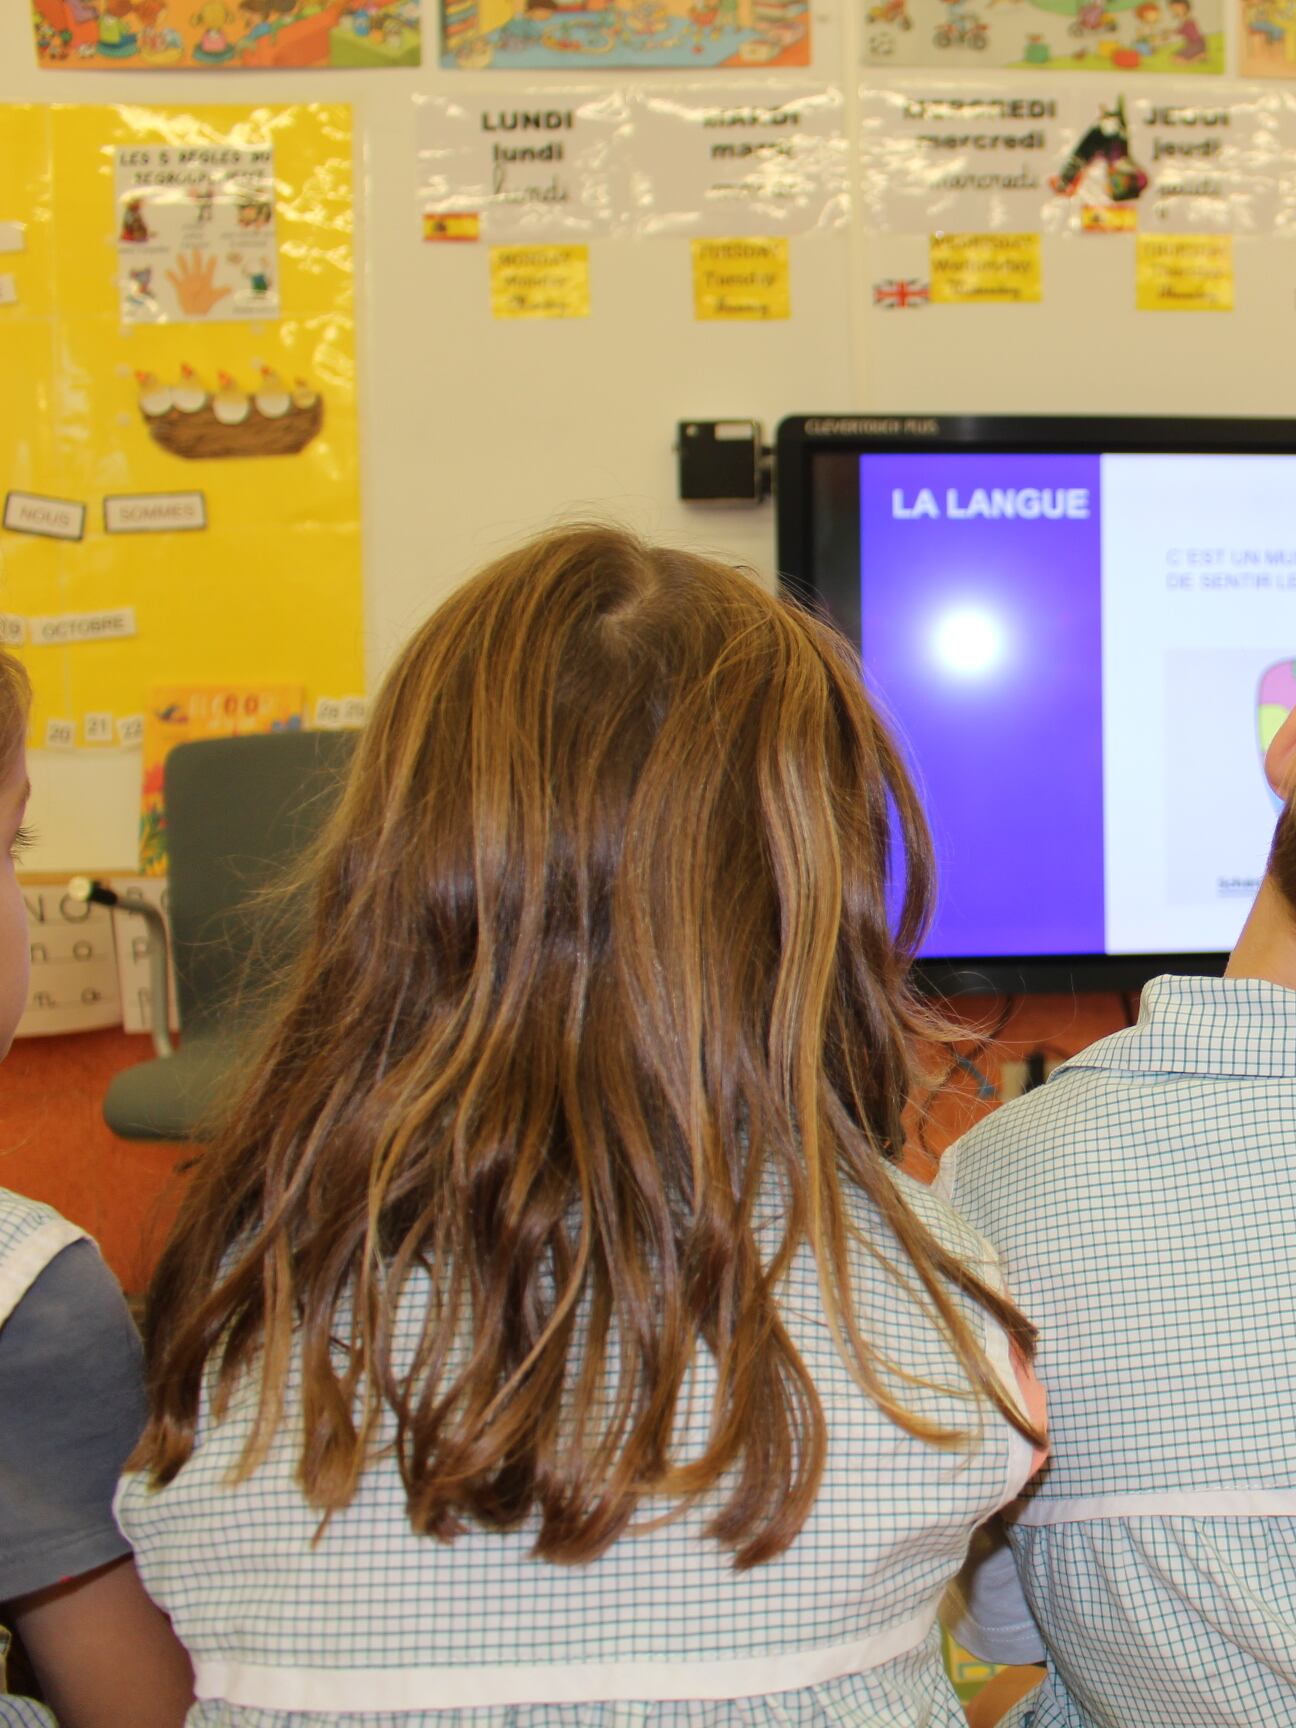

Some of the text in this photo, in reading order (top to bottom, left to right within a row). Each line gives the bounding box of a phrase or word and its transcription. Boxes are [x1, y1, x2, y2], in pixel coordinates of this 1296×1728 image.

[481, 110, 574, 132] LUNDI
[119, 150, 150, 167] LES
[491, 142, 564, 163] lundi
[119, 503, 194, 523] SOMMES
[890, 486, 1091, 521] LA LANGUE
[20, 504, 71, 529] NOUS
[41, 613, 126, 639] OCTOBRE
[49, 724, 70, 741] 20
[87, 720, 108, 735] 21
[73, 940, 93, 962] o
